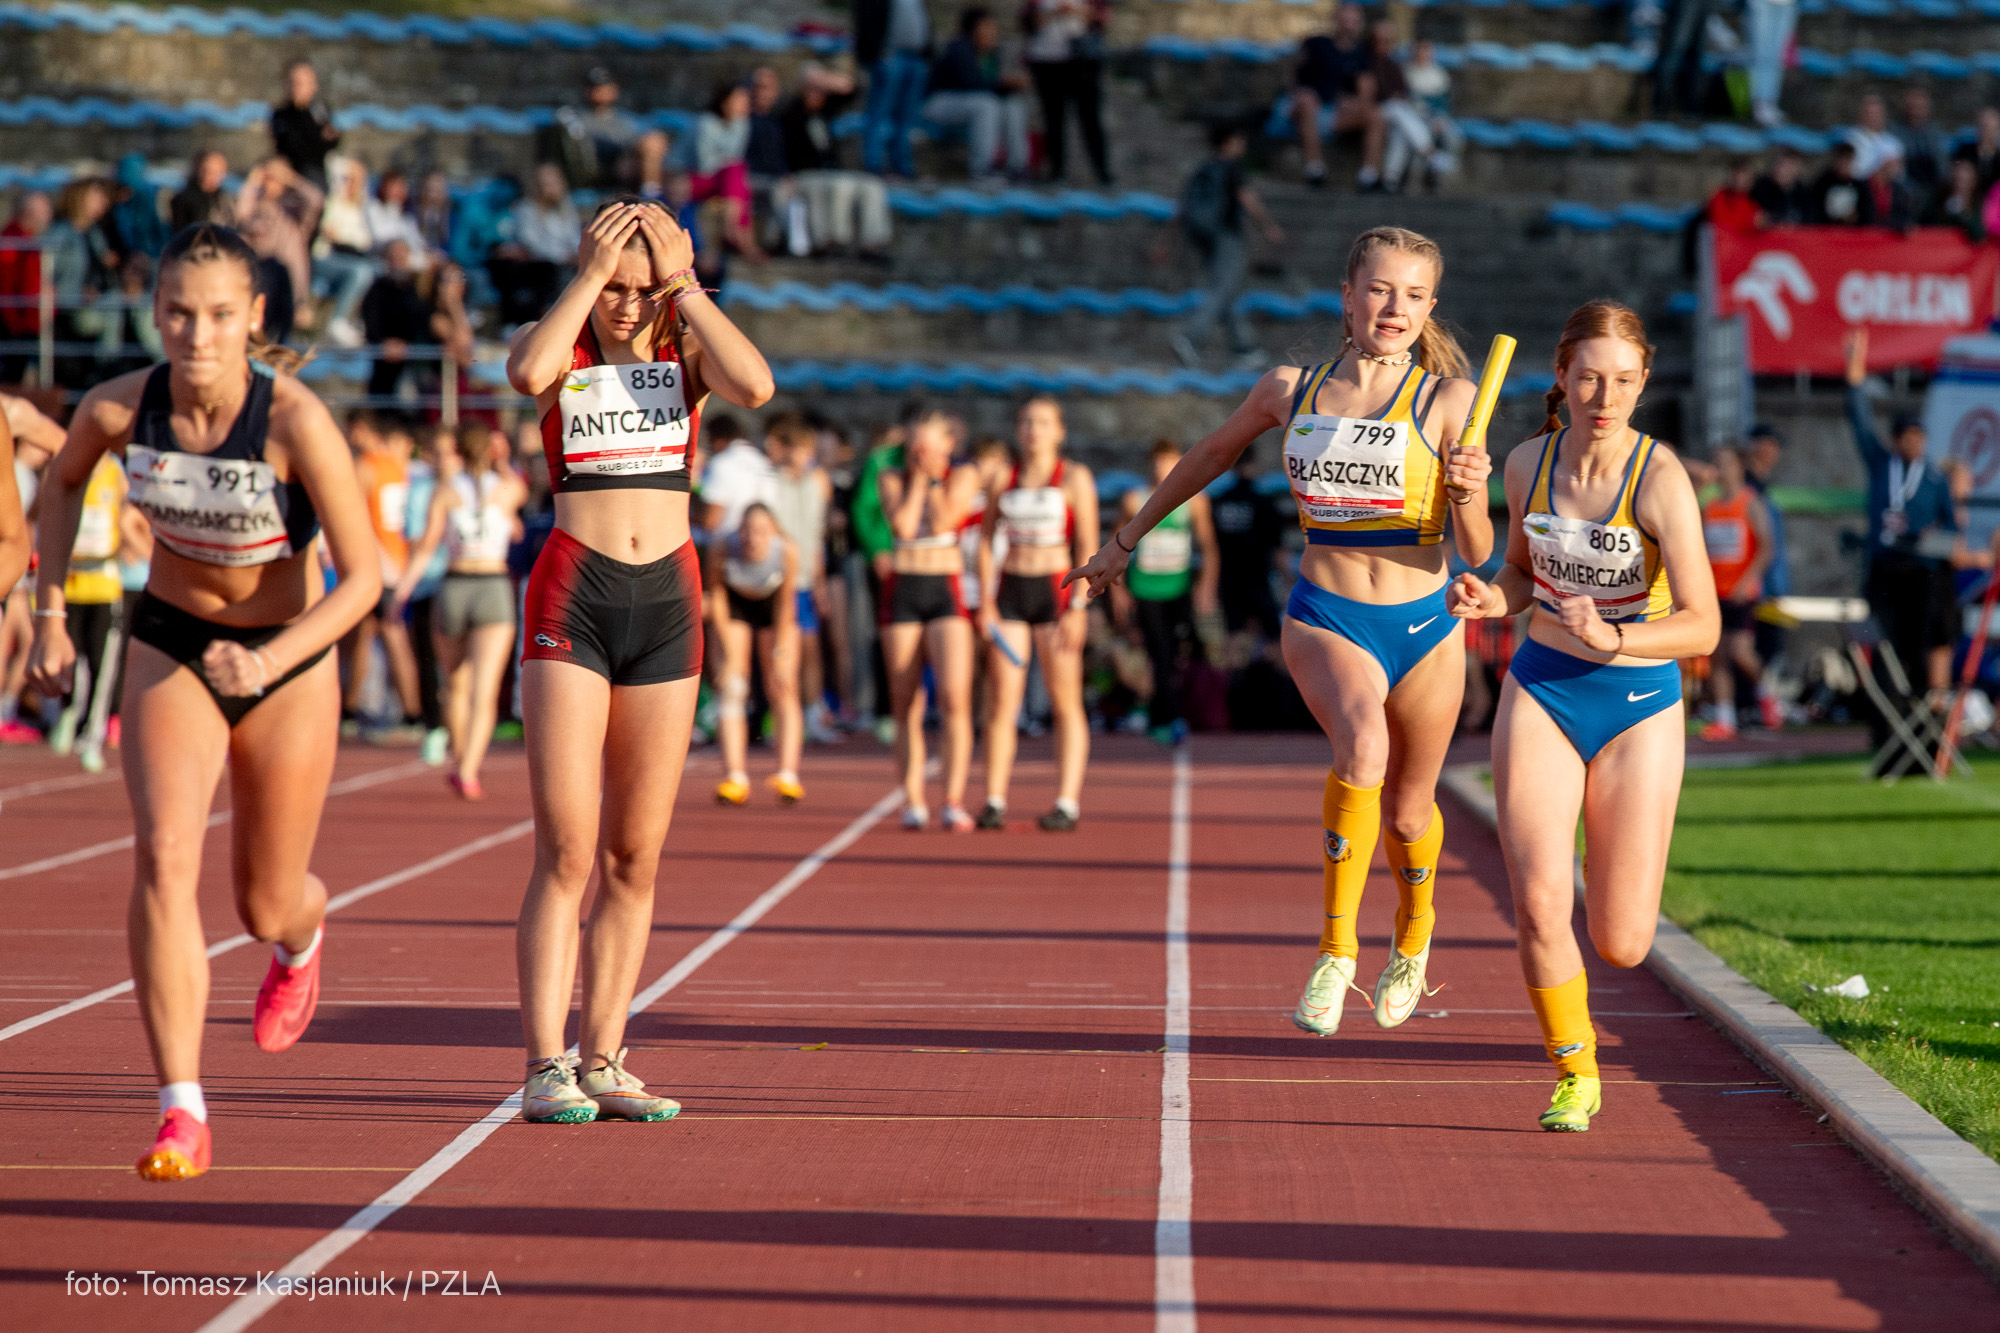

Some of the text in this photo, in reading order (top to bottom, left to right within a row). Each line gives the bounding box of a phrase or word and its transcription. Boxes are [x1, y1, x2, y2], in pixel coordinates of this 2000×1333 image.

[1837, 270, 1974, 327] ORLEN
[631, 367, 675, 390] 856
[569, 407, 684, 439] ANTCZAK
[1353, 424, 1396, 446] 799
[207, 465, 257, 493] 991
[596, 462, 641, 473] SŁUBICE
[1288, 456, 1400, 487] BŁASZCZYK
[1589, 528, 1631, 553] 805
[1533, 552, 1643, 588] KAŹMIERCZAK
[1598, 608, 1619, 616] 023
